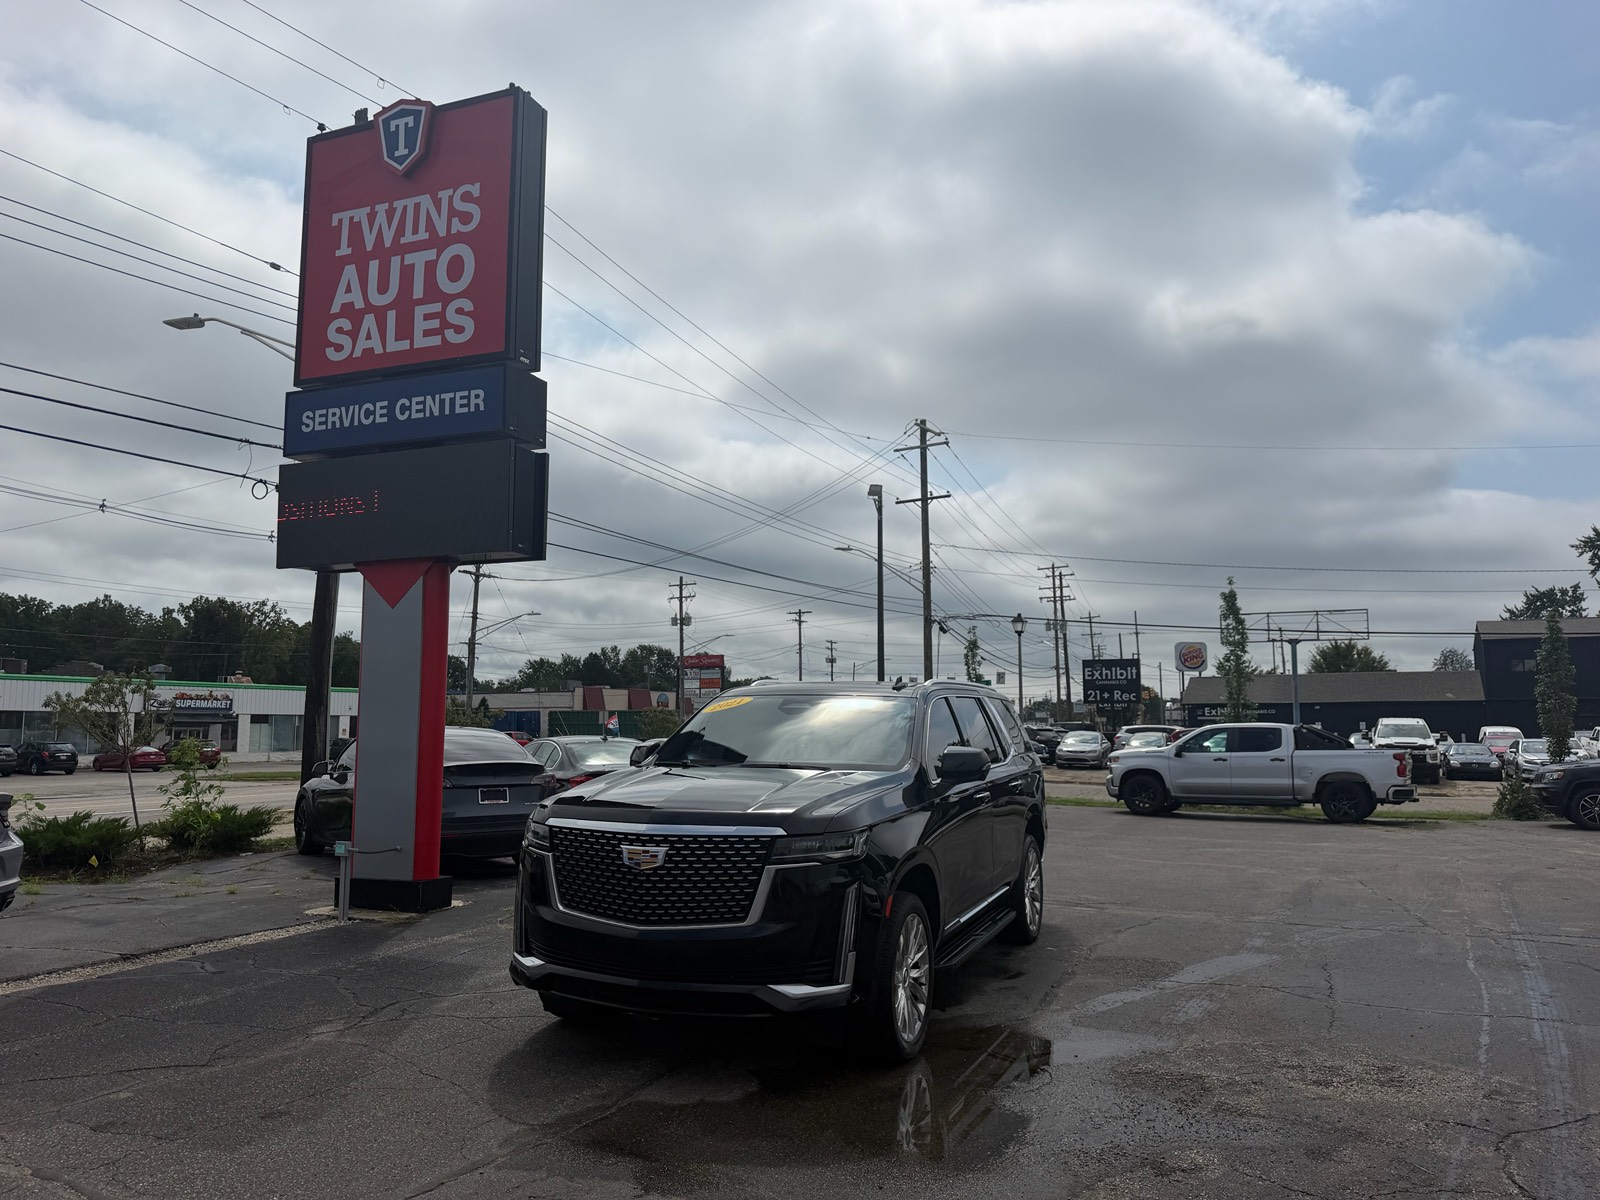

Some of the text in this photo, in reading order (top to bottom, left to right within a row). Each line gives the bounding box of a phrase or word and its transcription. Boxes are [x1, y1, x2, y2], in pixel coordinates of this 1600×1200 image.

[331, 182, 482, 257] TWINS
[329, 243, 476, 314] AUTO
[325, 298, 476, 362] SALES
[301, 388, 486, 433] SERVICE CENTER
[1181, 647, 1202, 659] BURGER
[1183, 651, 1204, 664] KING
[1084, 666, 1137, 680] Exhibit
[1087, 690, 1137, 701] 21+ Rec
[175, 699, 231, 709] SUPERMARKET
